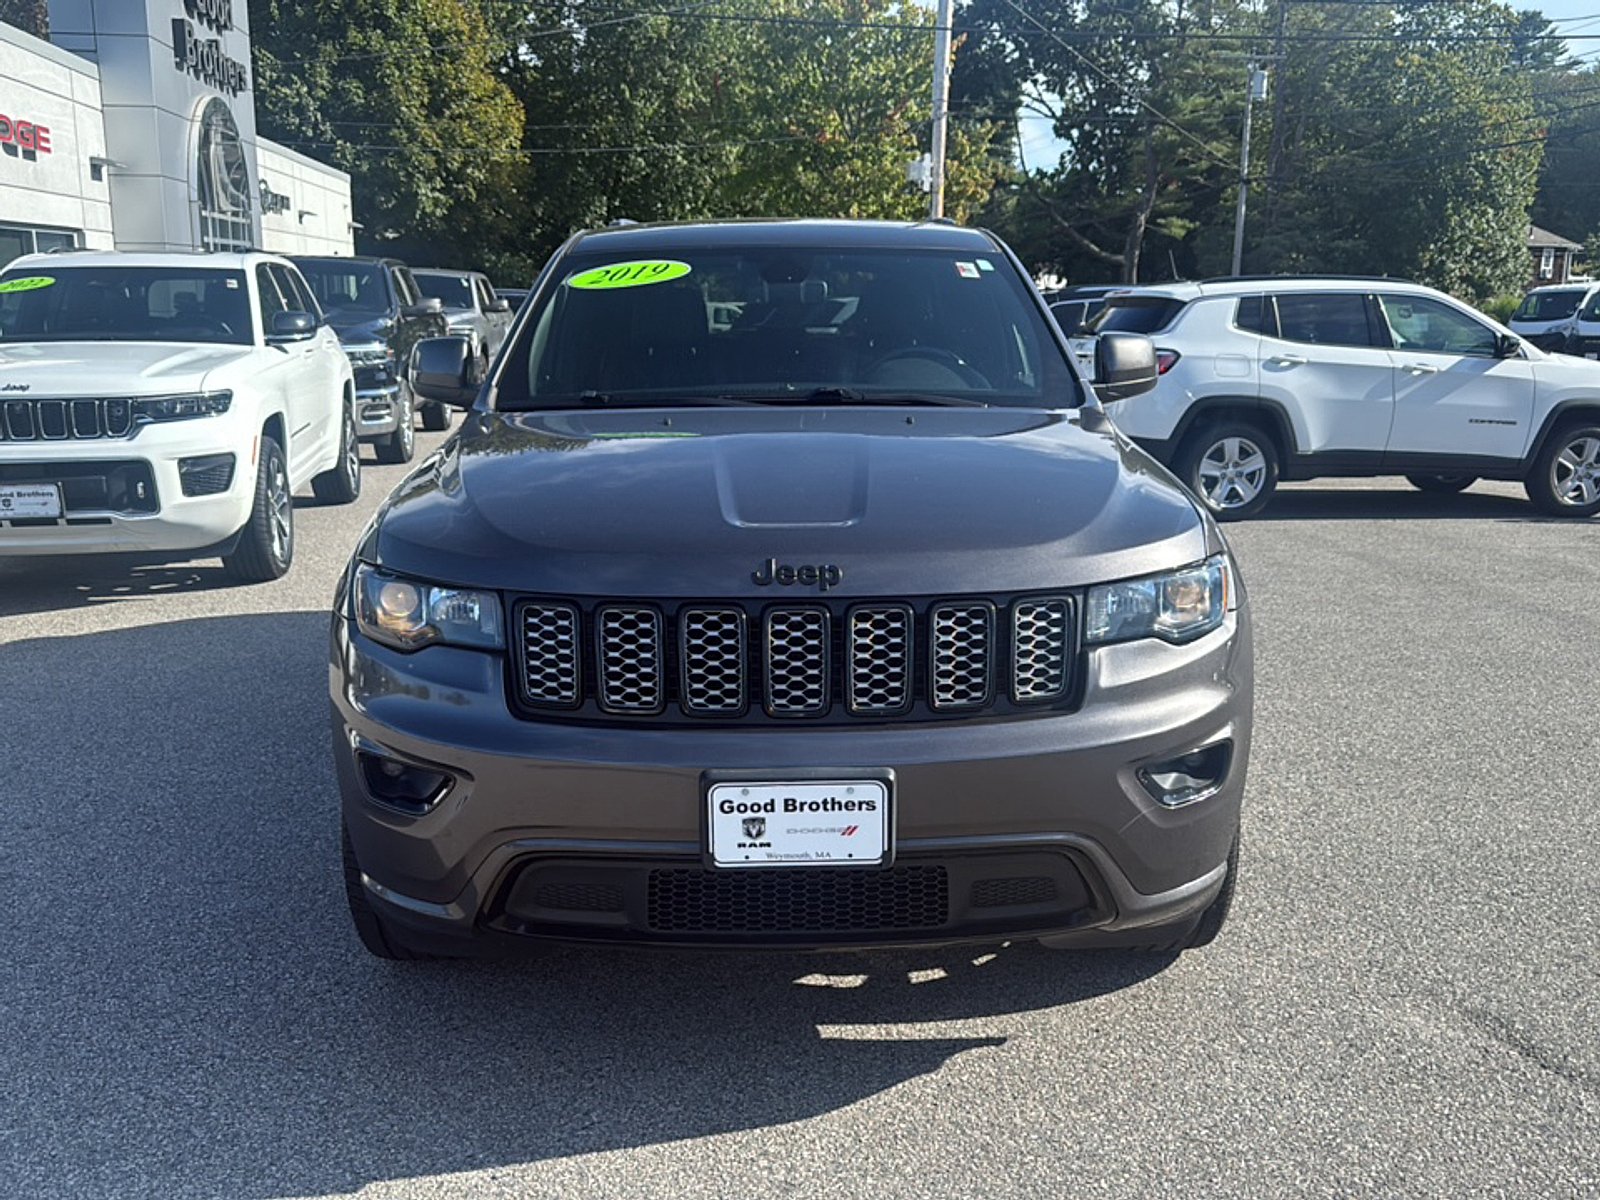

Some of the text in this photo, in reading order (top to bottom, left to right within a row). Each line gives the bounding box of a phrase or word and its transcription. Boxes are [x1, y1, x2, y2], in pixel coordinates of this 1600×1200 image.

[184, 0, 233, 36] ood
[173, 19, 246, 96] Brothers
[586, 263, 670, 285] 2019
[751, 558, 843, 591] Jeep
[719, 797, 877, 814] Good Brothers
[737, 841, 772, 849] RAM
[815, 851, 832, 859] MA
